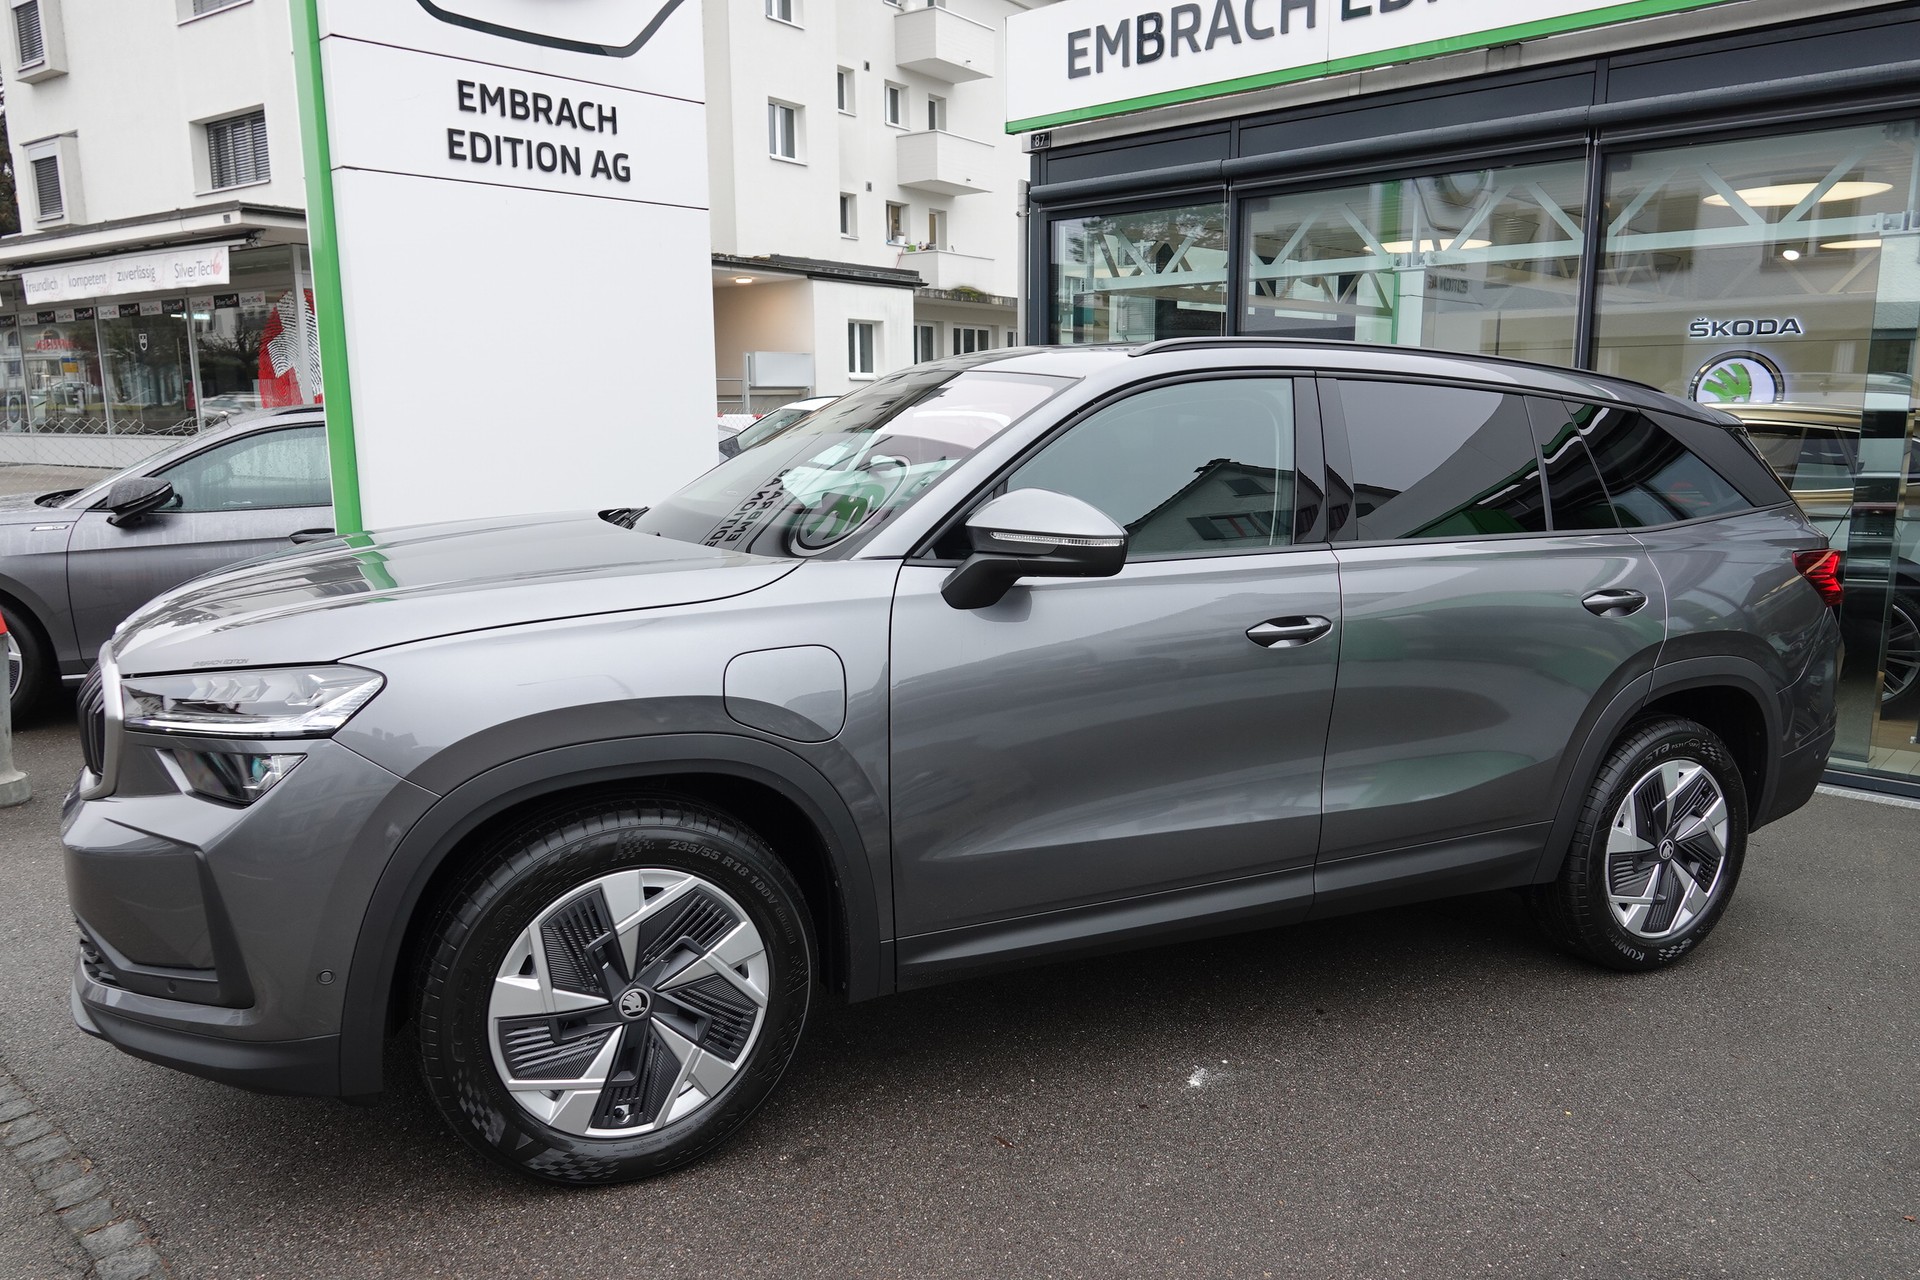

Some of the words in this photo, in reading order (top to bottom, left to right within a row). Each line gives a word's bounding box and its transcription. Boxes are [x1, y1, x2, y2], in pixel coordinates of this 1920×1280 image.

[1067, 0, 1316, 80] EMBRACH
[457, 79, 618, 135] EMBRACH
[447, 127, 582, 177] EDITION
[591, 149, 631, 182] AG
[1034, 134, 1045, 147] 87
[26, 276, 59, 293] freundlich
[68, 273, 107, 290] kompetent
[117, 264, 156, 282] zuverlässig
[174, 258, 215, 279] SilverTech
[1689, 318, 1802, 337] ŠKODA
[668, 840, 721, 860] 235/55
[721, 856, 750, 877] R18
[750, 875, 778, 904] 100V
